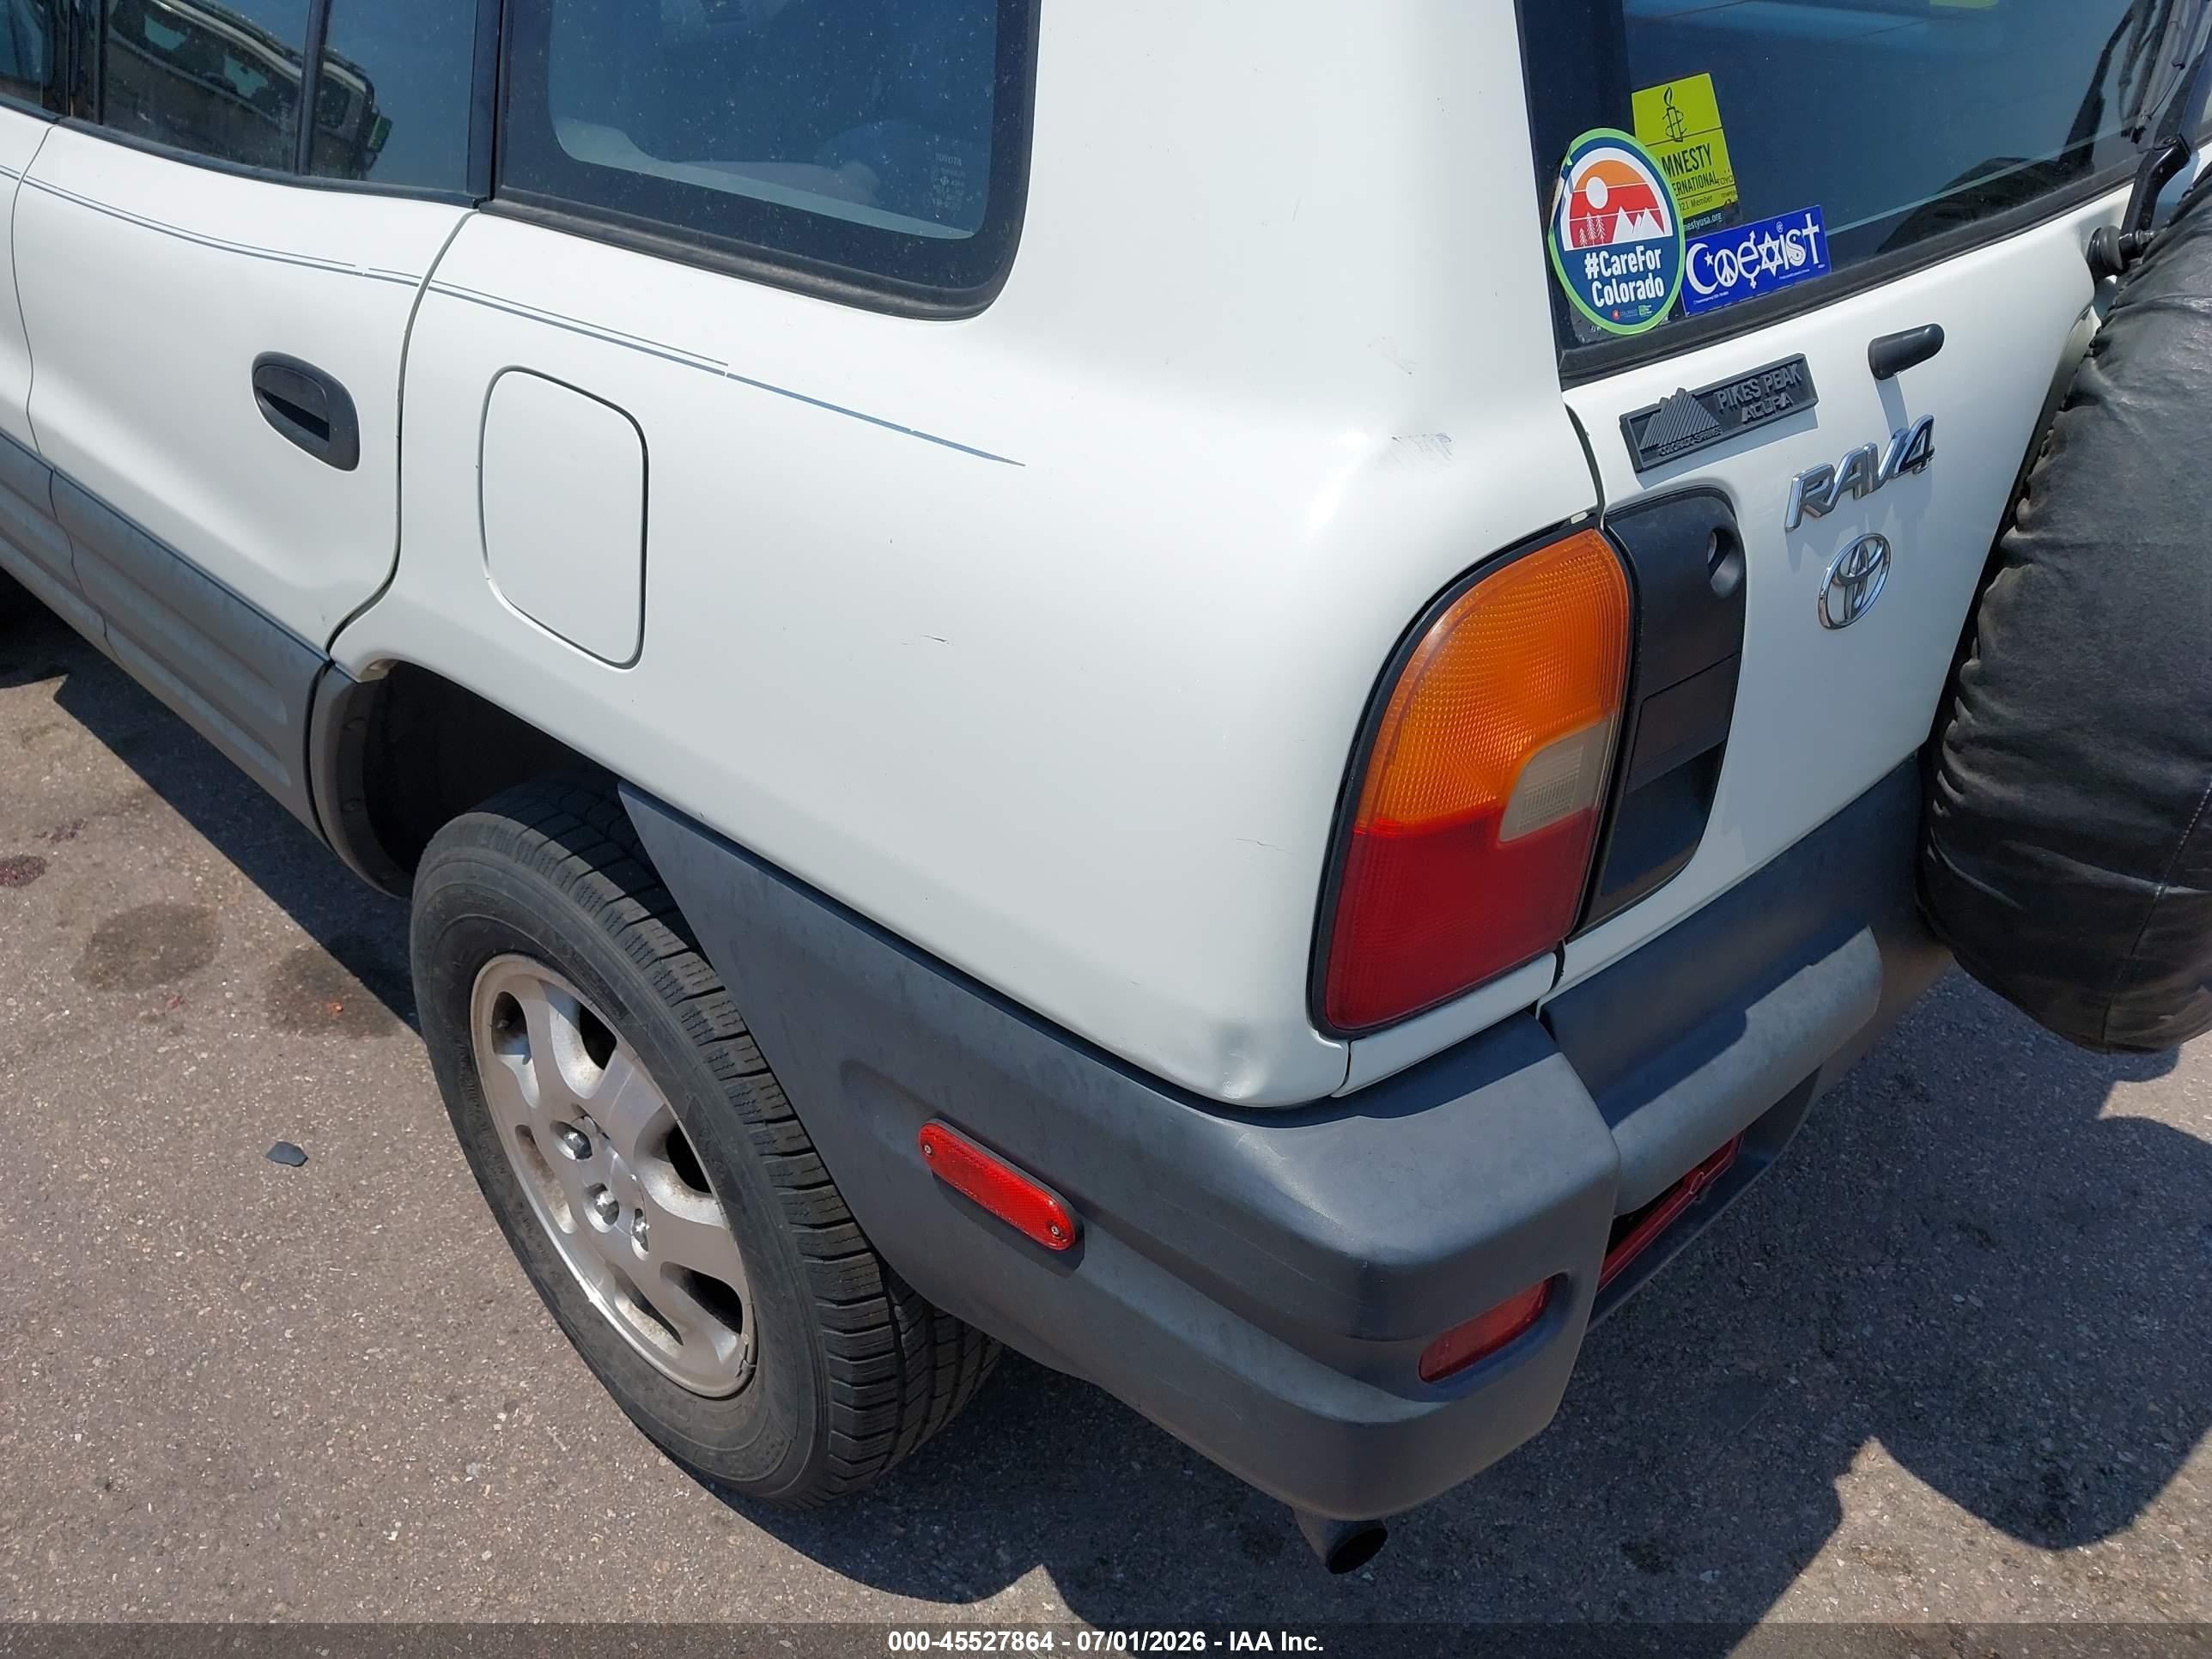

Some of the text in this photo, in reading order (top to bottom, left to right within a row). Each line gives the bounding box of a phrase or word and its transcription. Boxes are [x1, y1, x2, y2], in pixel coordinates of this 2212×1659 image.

[1661, 143, 1712, 178] MNESTY
[1672, 169, 1718, 197] ERNATIONAL
[1691, 195, 1713, 207] Member
[1683, 212, 1722, 232] nestyusa.org
[1584, 245, 1662, 280] #CareFor
[1591, 272, 1665, 307] Colorado
[1716, 363, 1802, 408] PIKES PEAK
[1741, 392, 1794, 422] ACURA
[1785, 414, 1936, 532] RAV4
